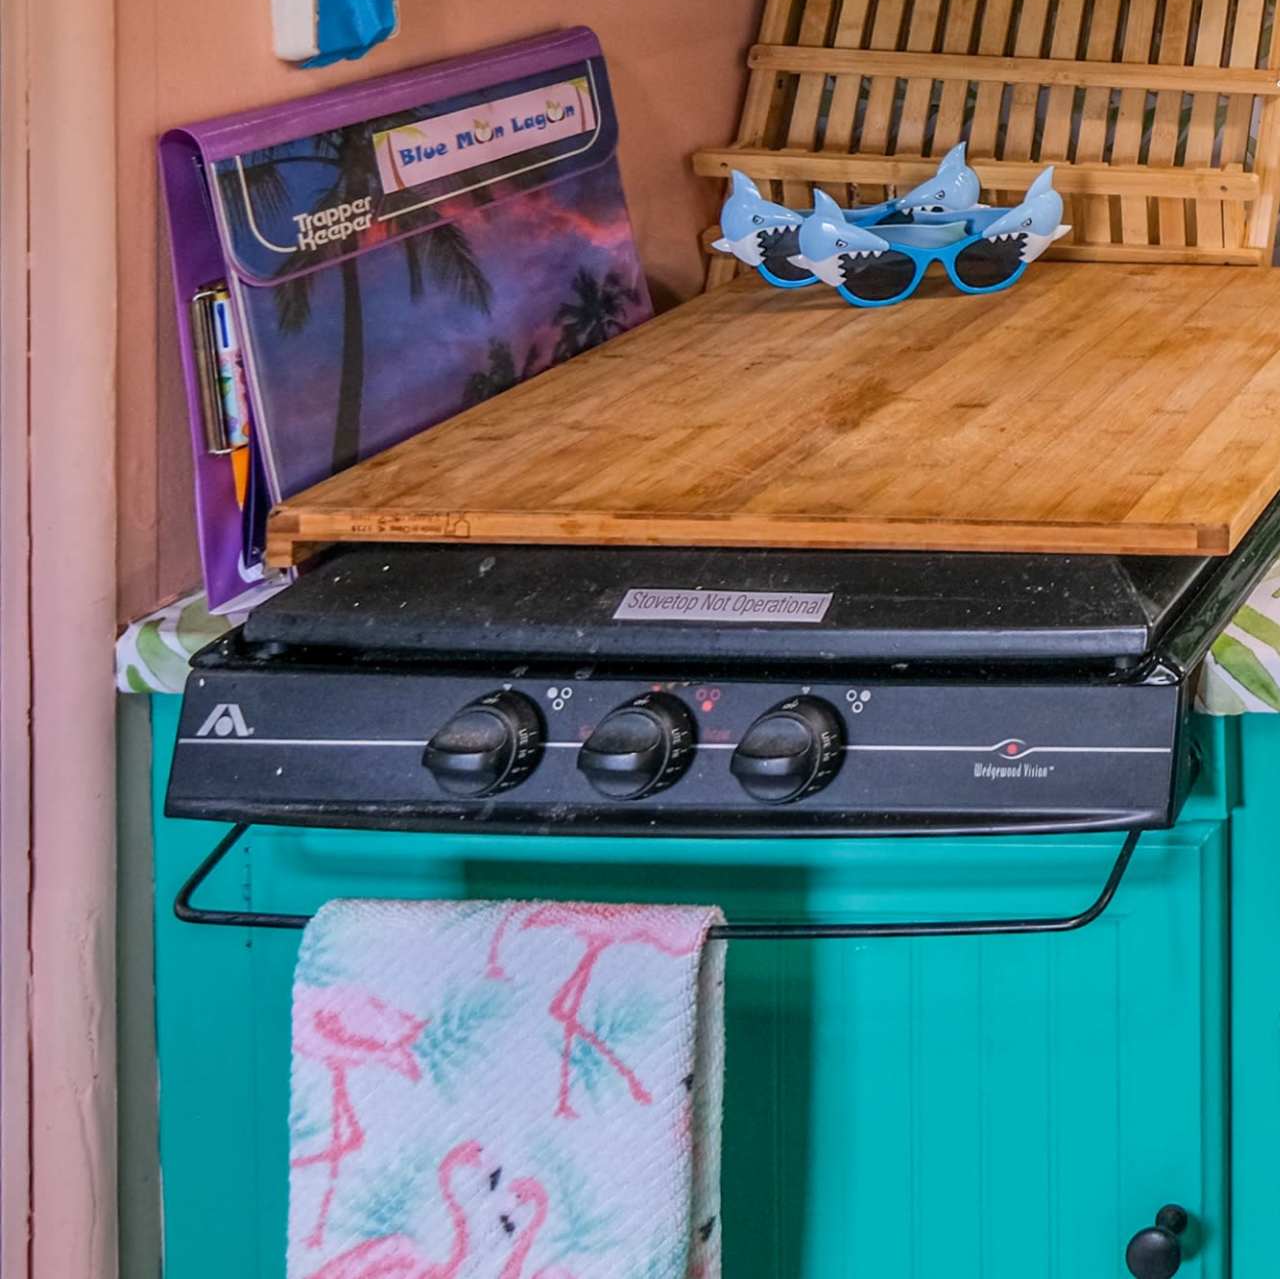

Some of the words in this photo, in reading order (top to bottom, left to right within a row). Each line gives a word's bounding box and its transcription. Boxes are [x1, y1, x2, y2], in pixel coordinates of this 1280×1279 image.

[399, 143, 448, 166] Blue
[292, 196, 372, 232] Trapper
[297, 213, 373, 251] Keeper
[628, 591, 699, 610] Stovetop
[700, 594, 731, 612] Not
[732, 594, 826, 615] Operational
[974, 762, 1022, 781] Wedgewood
